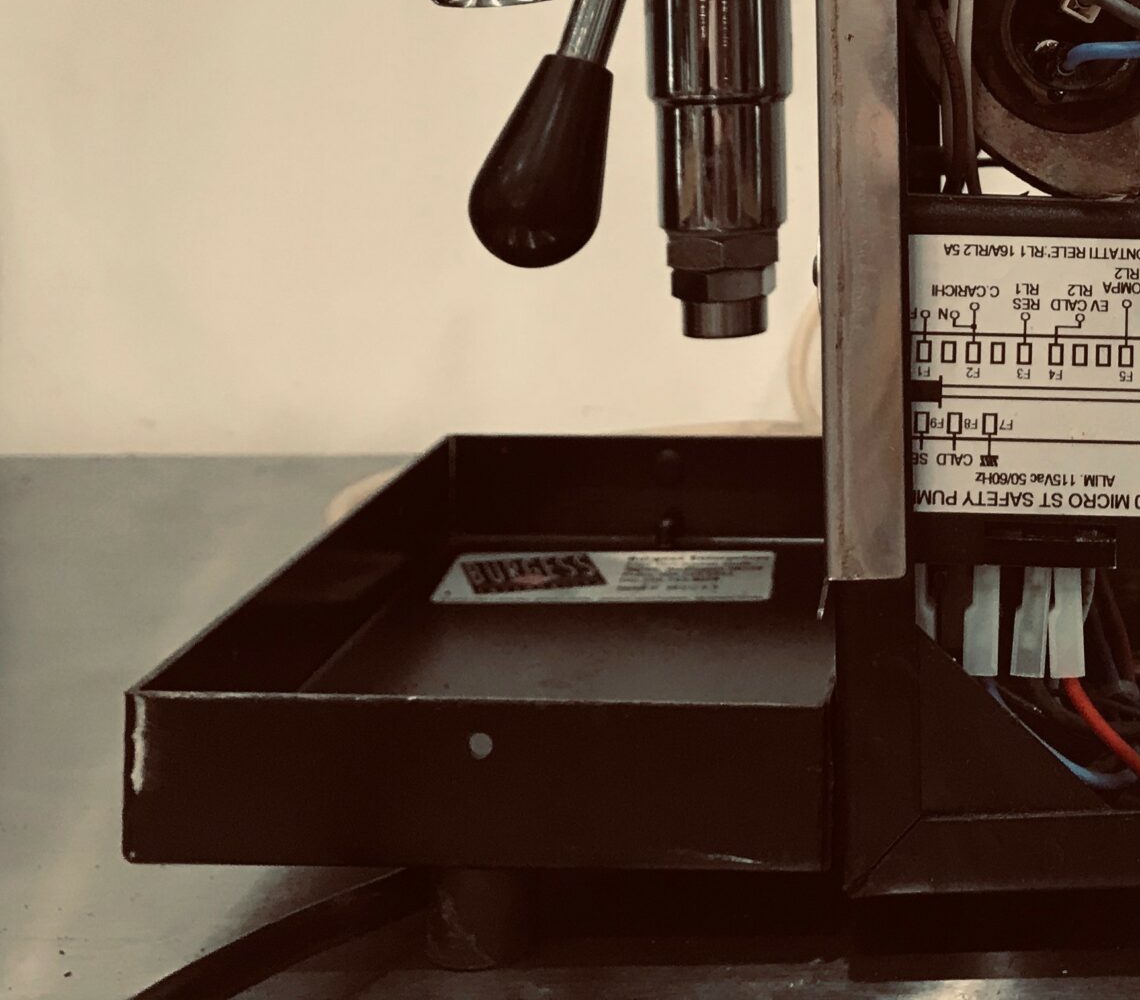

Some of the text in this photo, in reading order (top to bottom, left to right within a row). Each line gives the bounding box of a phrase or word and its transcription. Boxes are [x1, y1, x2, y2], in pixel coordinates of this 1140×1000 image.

[943, 243, 961, 256] 5A
[963, 243, 1015, 257] 16A/RL2
[1114, 267, 1140, 280] RL2
[931, 284, 1000, 298] C.CARICHI
[1015, 283, 1040, 296] RL1
[1067, 284, 1093, 297] RL2
[1012, 297, 1041, 311] RES
[1050, 298, 1109, 312] EV CALD
[937, 307, 949, 321] N
[917, 366, 931, 377] F1
[965, 366, 981, 379] F2
[1016, 367, 1031, 380] F3
[1048, 368, 1063, 381] F4
[1119, 370, 1133, 383] F5
[930, 417, 945, 429] F9
[963, 417, 978, 430] F8
[999, 419, 1014, 431] F7
[936, 453, 973, 466] CALD
[975, 471, 1116, 488] ALIM. 115Vac 50/60Hz
[913, 489, 957, 506] PUM
[962, 490, 1034, 508] SAFETY
[1039, 491, 1063, 509] ST
[1068, 492, 1130, 510] MICRO
